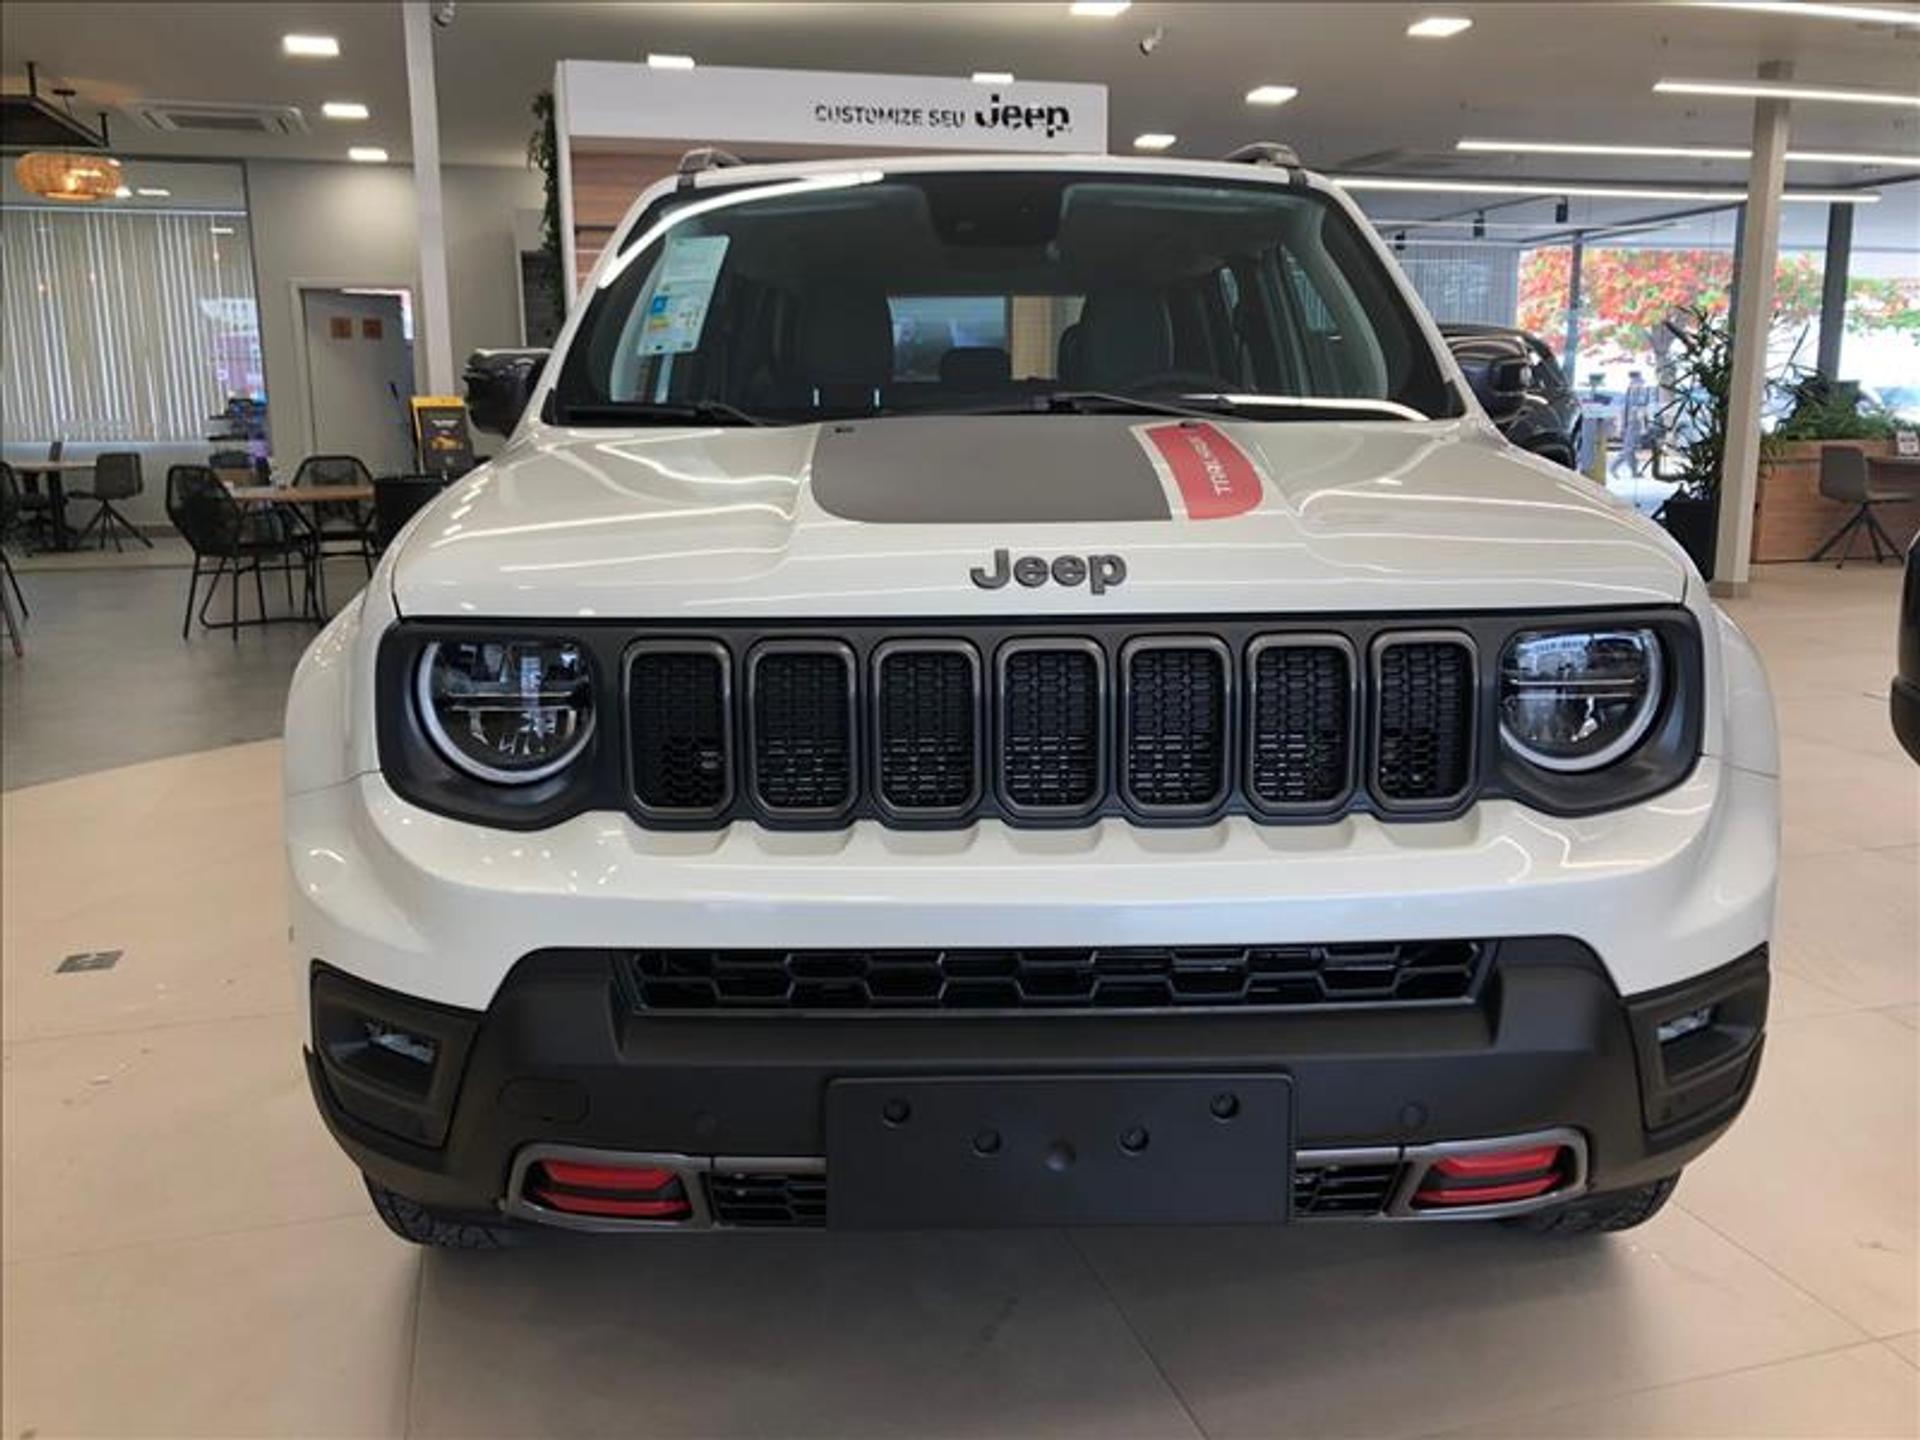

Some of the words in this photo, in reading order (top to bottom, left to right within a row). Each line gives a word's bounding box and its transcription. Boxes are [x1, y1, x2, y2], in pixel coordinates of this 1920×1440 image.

[815, 104, 923, 126] CUSTOMIZE
[928, 109, 966, 128] SEU
[970, 548, 1127, 595] Jeep
